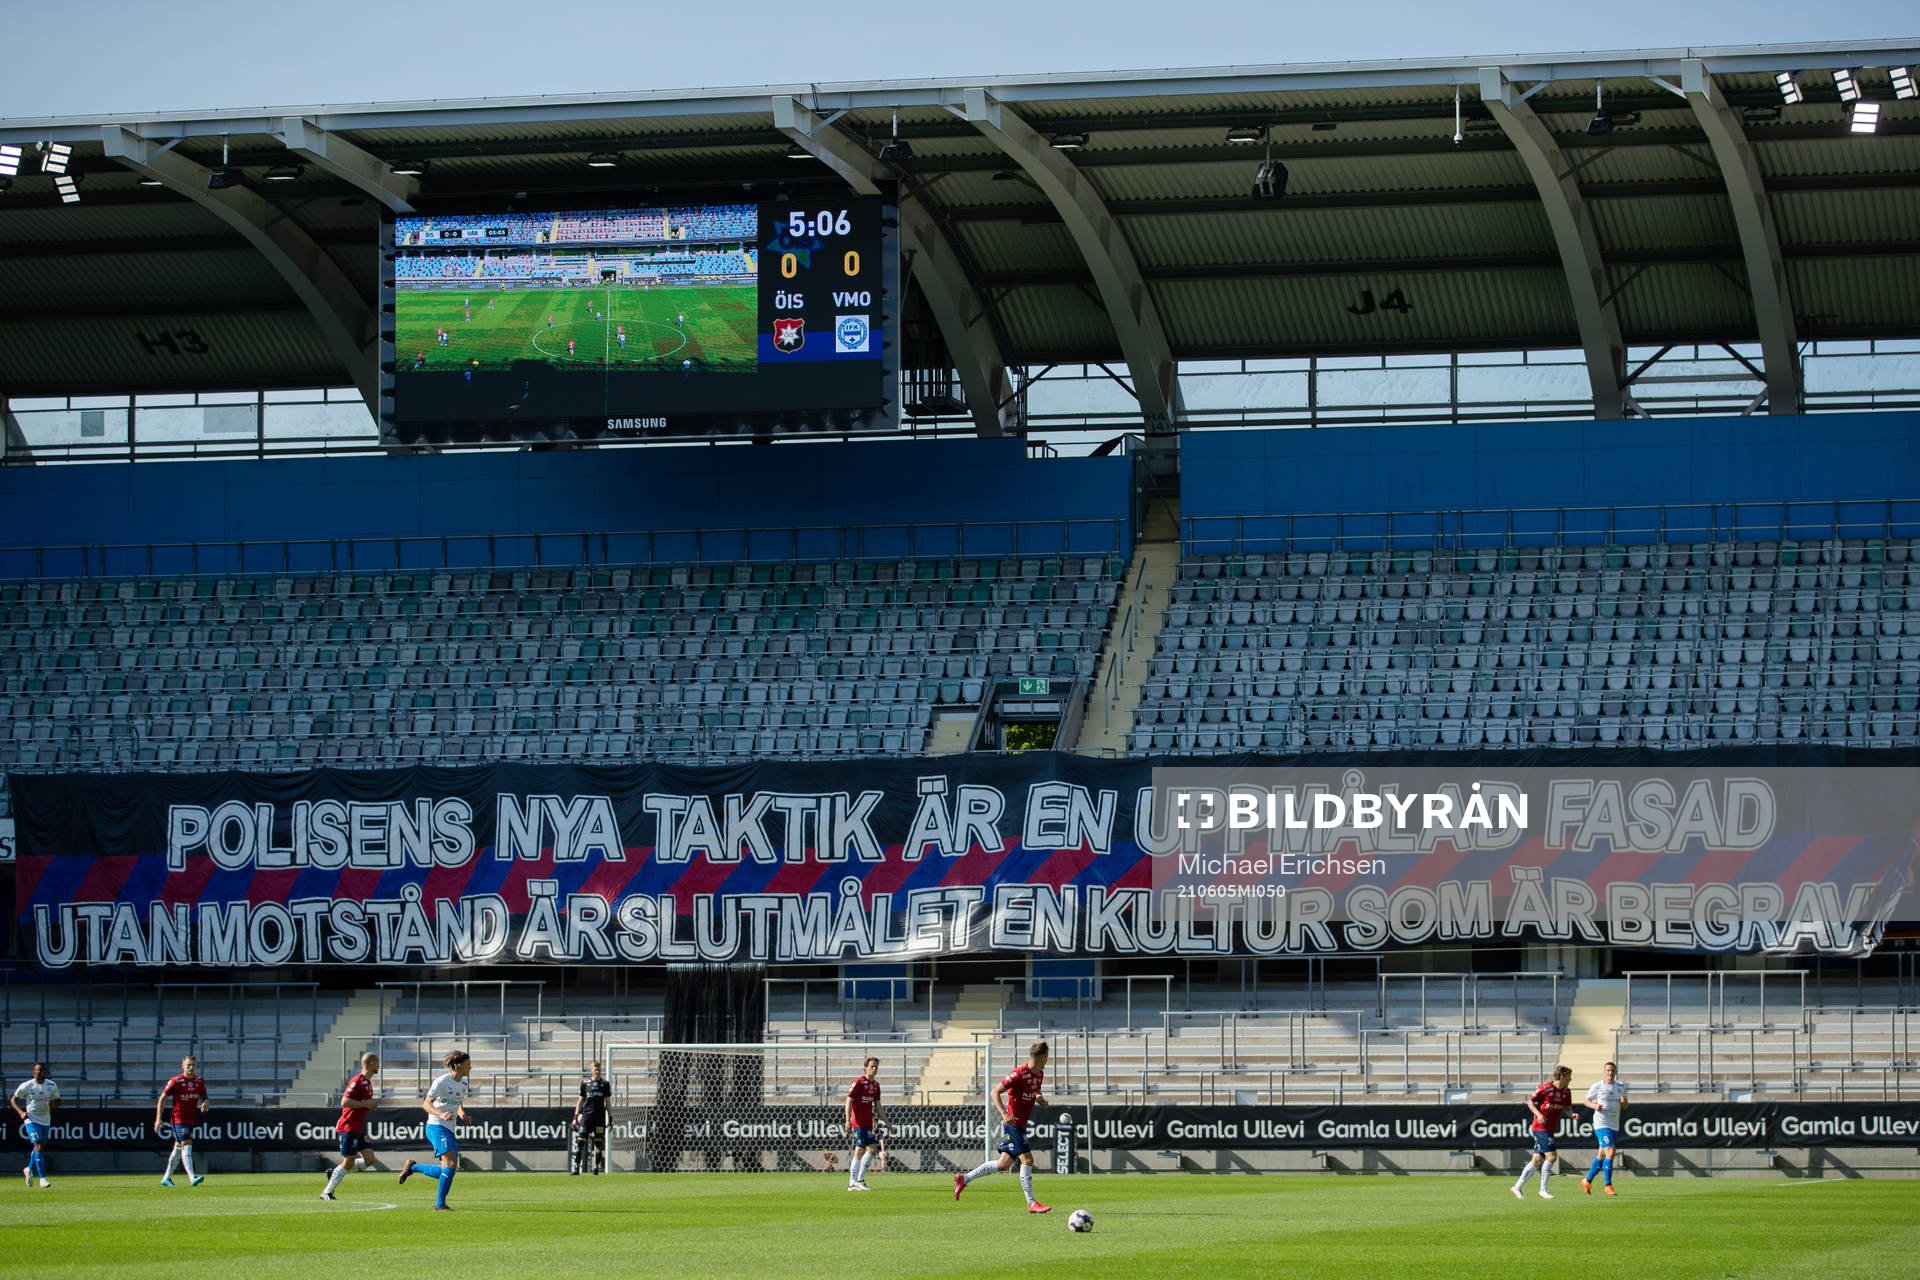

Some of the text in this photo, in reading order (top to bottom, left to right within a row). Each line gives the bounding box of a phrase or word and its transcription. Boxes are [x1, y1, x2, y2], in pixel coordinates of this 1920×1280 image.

[789, 210, 851, 237] 5:06
[781, 250, 860, 279] 0 0
[775, 290, 871, 310] ÖIS VMO
[1347, 289, 1413, 315] J4
[136, 331, 209, 355] H3
[607, 417, 667, 429] SAMSUNG
[167, 769, 1776, 872] POLISENS NYA TAKTIK ÄR EN UPPMÅLAD FASAD
[33, 865, 1878, 969] UTAN MOTSTÅND ÄR SLUTMÅLET EN KULTUR SOM ÄR BEGRAV
[89, 1121, 145, 1140] Ullevi
[227, 1121, 284, 1140] Ullevi
[295, 1121, 425, 1140] Gam Ullevi
[454, 1121, 568, 1140] amla Ullevi
[723, 1120, 792, 1138] Gamla
[1094, 1120, 1154, 1138] Ullevi
[1167, 1119, 1305, 1139] Gamla Ullevi
[1318, 1119, 1457, 1138] Gamla Ullevi
[1624, 1117, 1767, 1137] Gamla Ullevi
[1781, 1116, 1920, 1136] Gamla Ullev
[1057, 1130, 1070, 1174] SELECT
